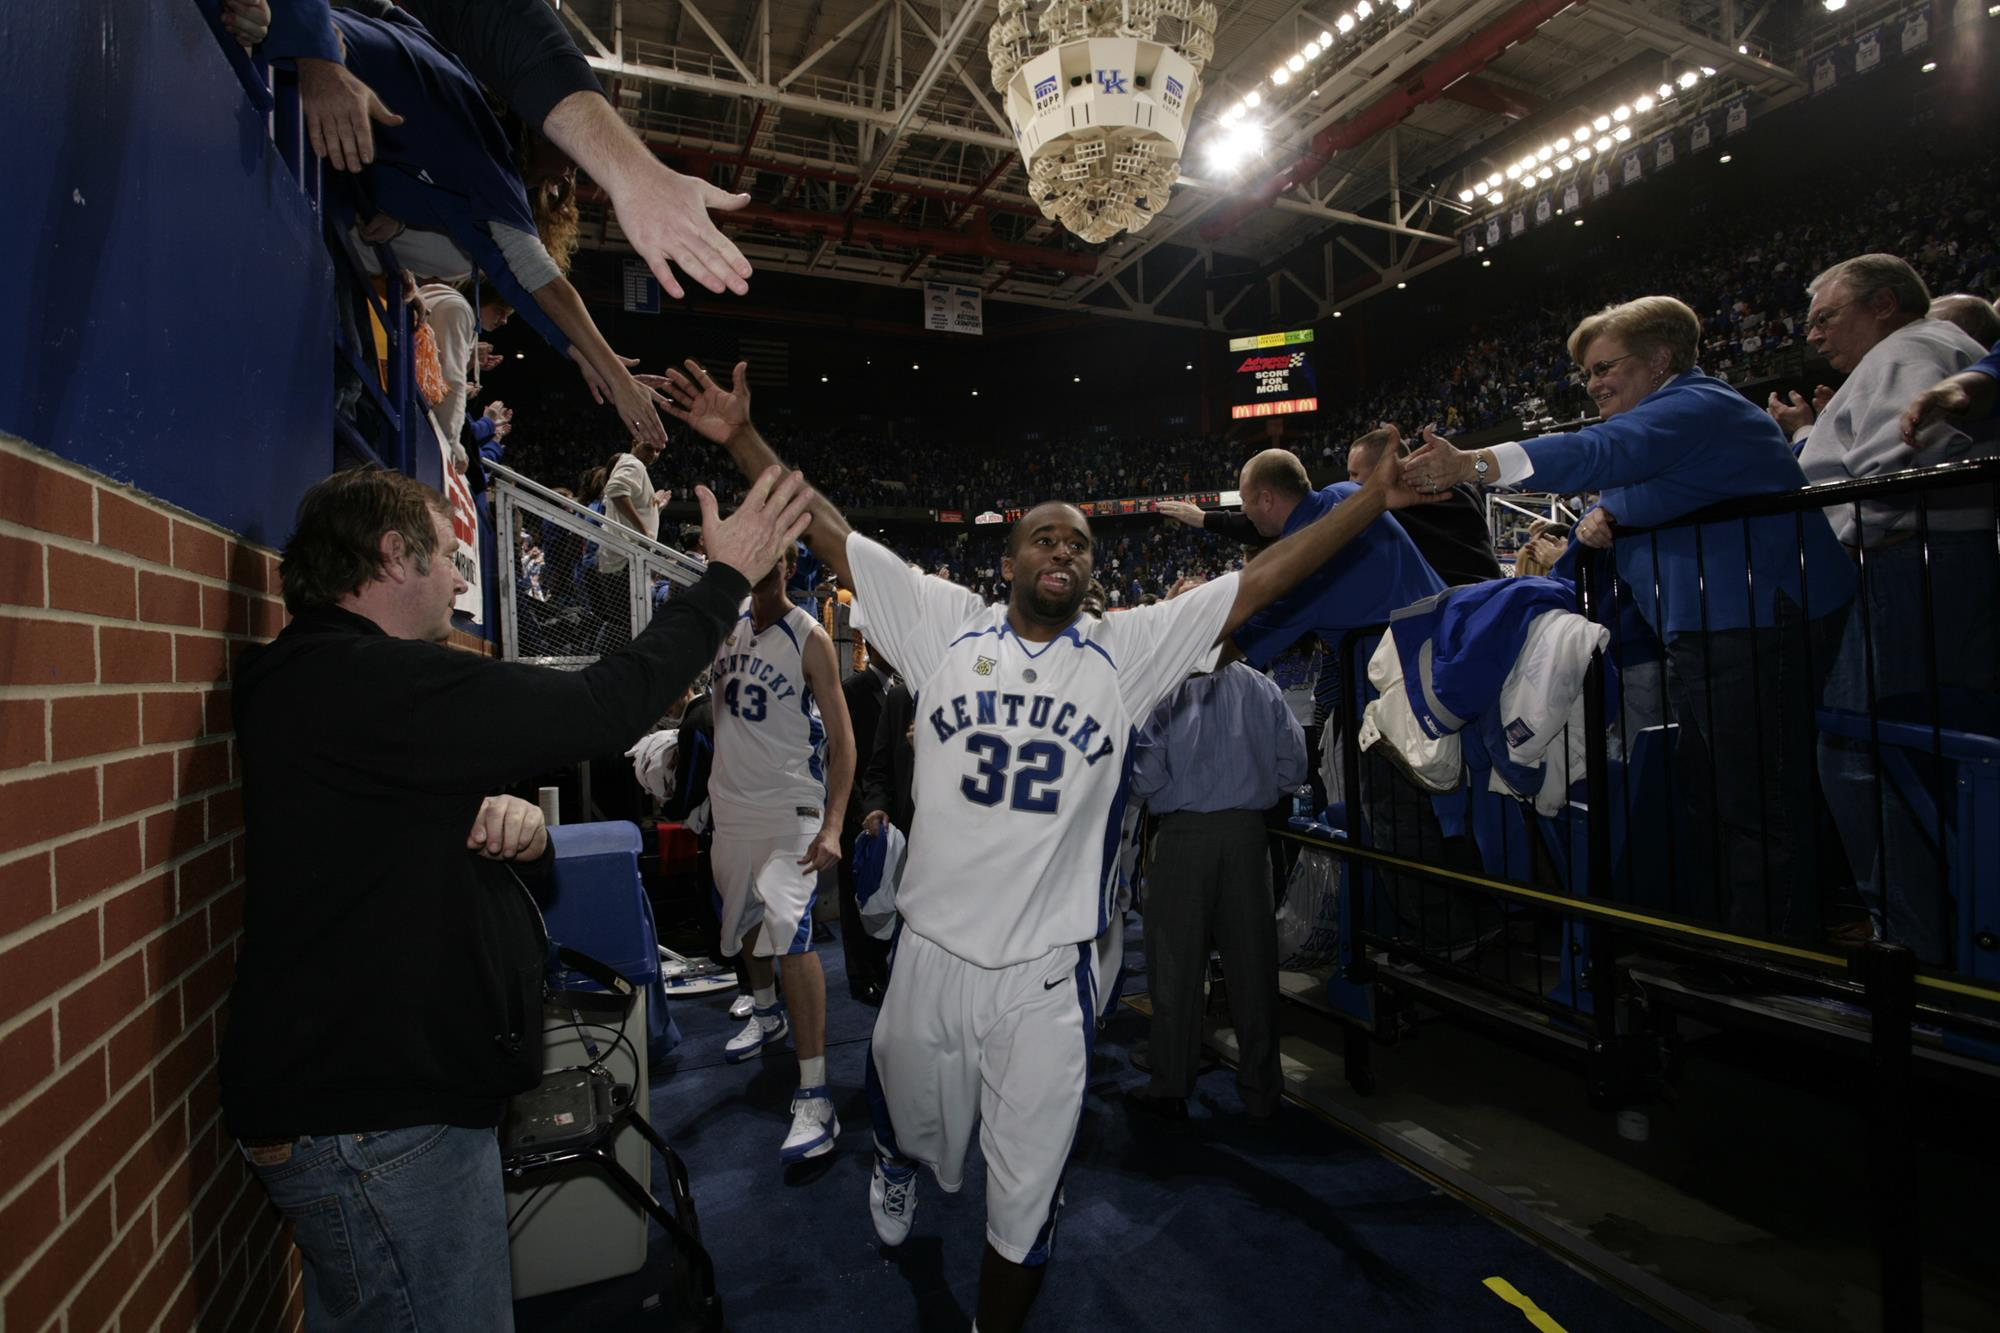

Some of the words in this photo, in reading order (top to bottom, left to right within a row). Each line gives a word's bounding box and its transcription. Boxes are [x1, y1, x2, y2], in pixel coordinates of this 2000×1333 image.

[1095, 69, 1128, 94] UK
[1037, 92, 1060, 111] RUPP
[1163, 92, 1181, 110] RUPP
[1255, 370, 1289, 379] SCORE
[1262, 377, 1283, 386] FOR
[1256, 383, 1289, 394] MORE
[725, 677, 767, 722] 43
[930, 690, 1114, 767] KENTUCKY
[959, 731, 1066, 815] 32
